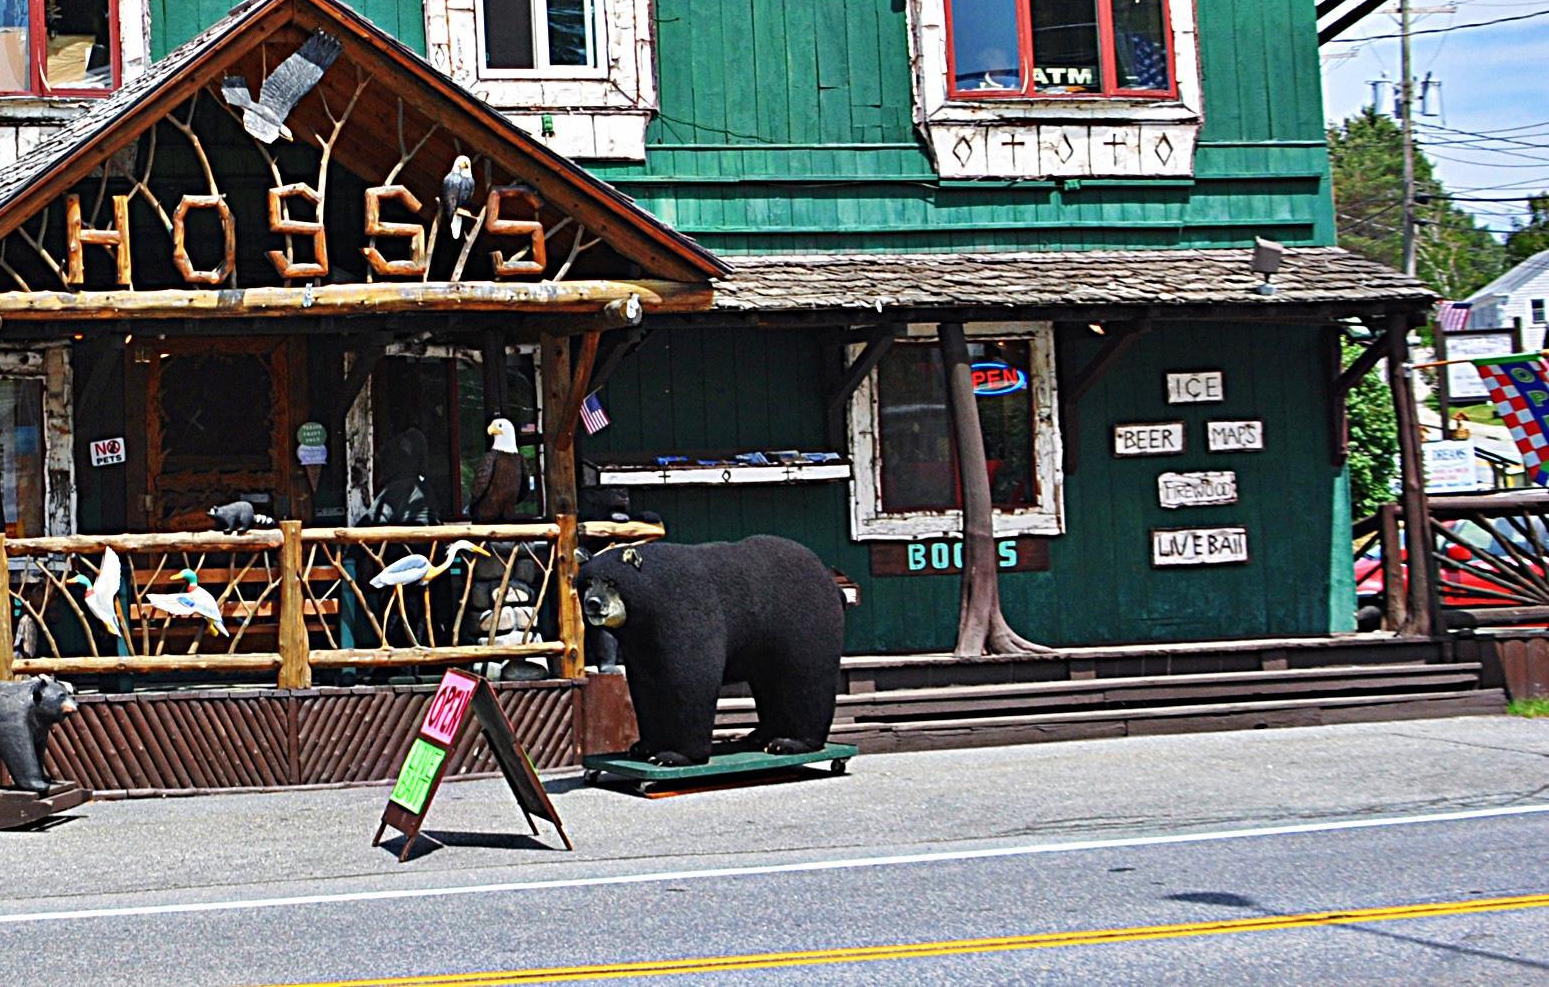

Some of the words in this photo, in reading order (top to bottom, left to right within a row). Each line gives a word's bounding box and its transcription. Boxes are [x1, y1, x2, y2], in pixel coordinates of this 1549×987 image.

[1033, 67, 1092, 84] ATM
[971, 368, 1018, 391] PEN
[1175, 376, 1219, 398] ICE
[1124, 429, 1174, 450] BEER
[1212, 425, 1256, 447] MAPS
[95, 440, 120, 456] NO
[96, 454, 122, 465] PETS
[1159, 534, 1202, 556] LIVE
[427, 685, 471, 735] OPEN
